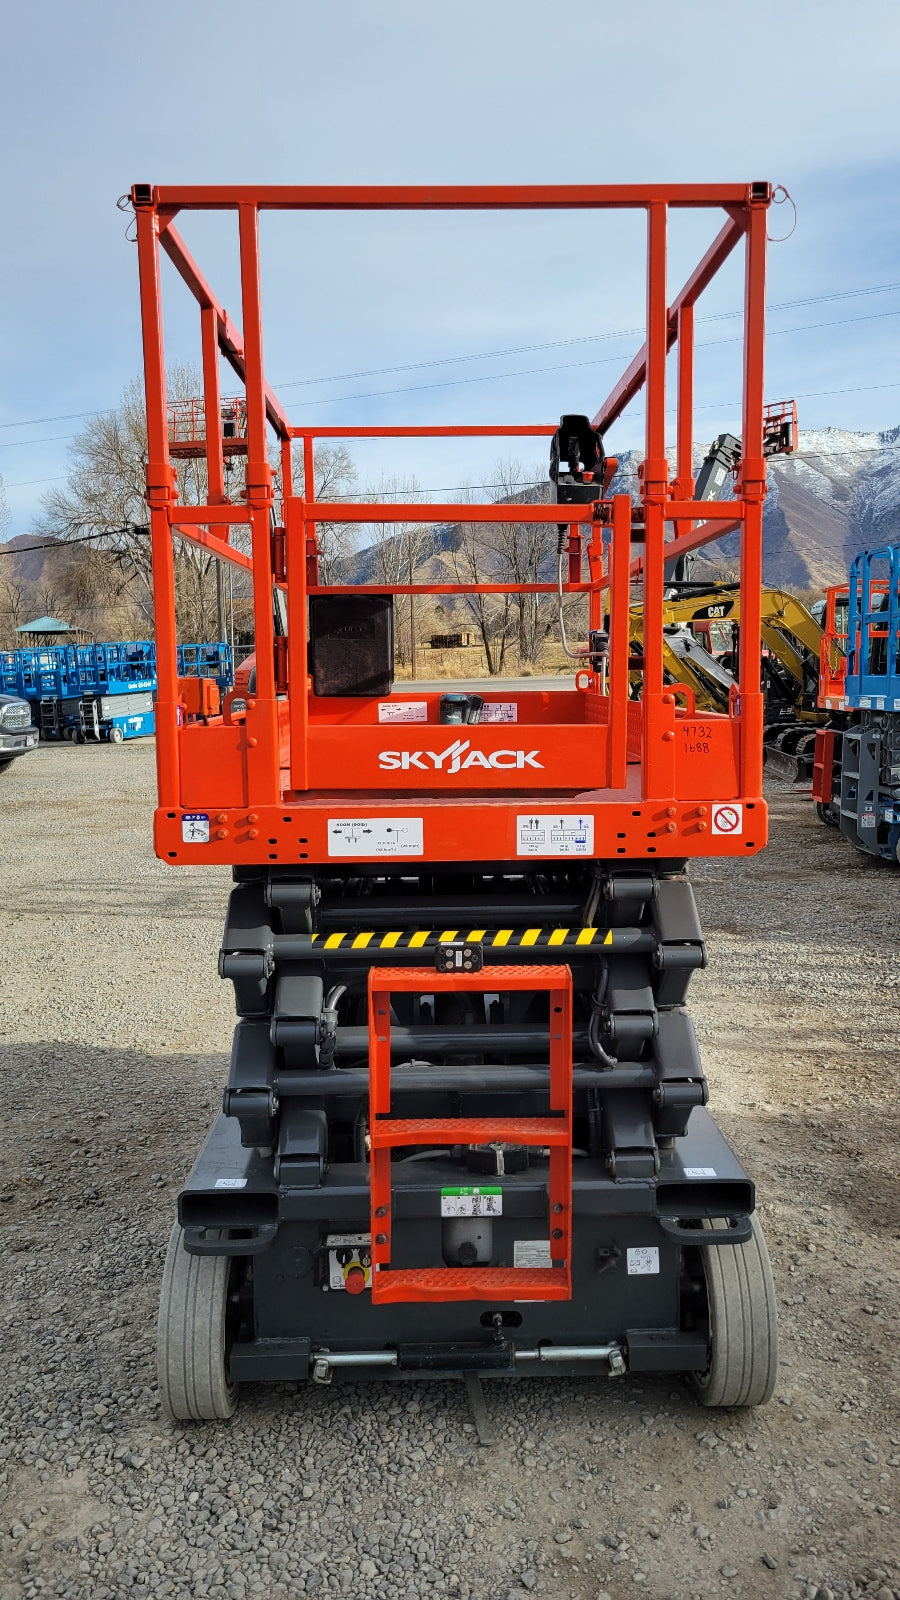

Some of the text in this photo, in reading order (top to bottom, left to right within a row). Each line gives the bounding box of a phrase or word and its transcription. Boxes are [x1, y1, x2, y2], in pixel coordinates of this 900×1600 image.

[707, 606, 725, 618] CAT
[683, 726, 712, 738] 4732
[684, 742, 710, 753] 1688
[378, 739, 545, 774] SKYJACK
